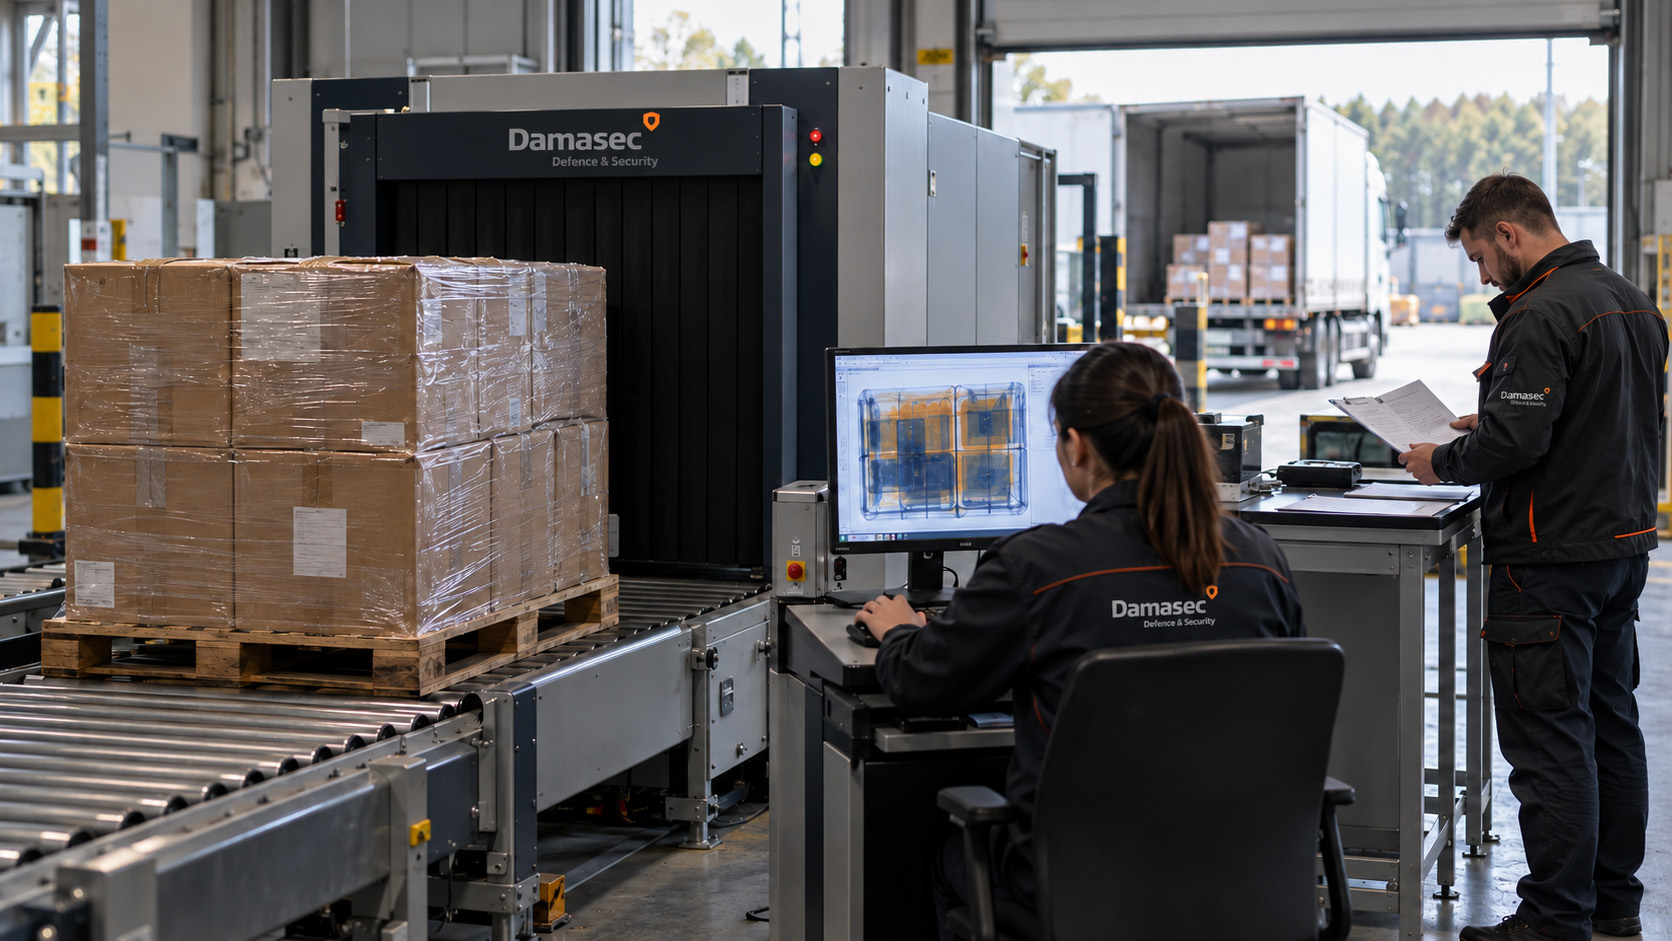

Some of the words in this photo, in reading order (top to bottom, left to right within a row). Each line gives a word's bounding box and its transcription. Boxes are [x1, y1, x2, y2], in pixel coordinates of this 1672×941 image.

[508, 128, 642, 151] Damasec
[552, 156, 598, 167] Defence
[600, 157, 609, 167] &
[611, 156, 659, 168] Security
[1500, 391, 1544, 400] Damasec
[1111, 599, 1207, 618] Damasec
[1143, 619, 1176, 628] Defence
[1177, 618, 1183, 626] &
[1184, 617, 1216, 626] Security
